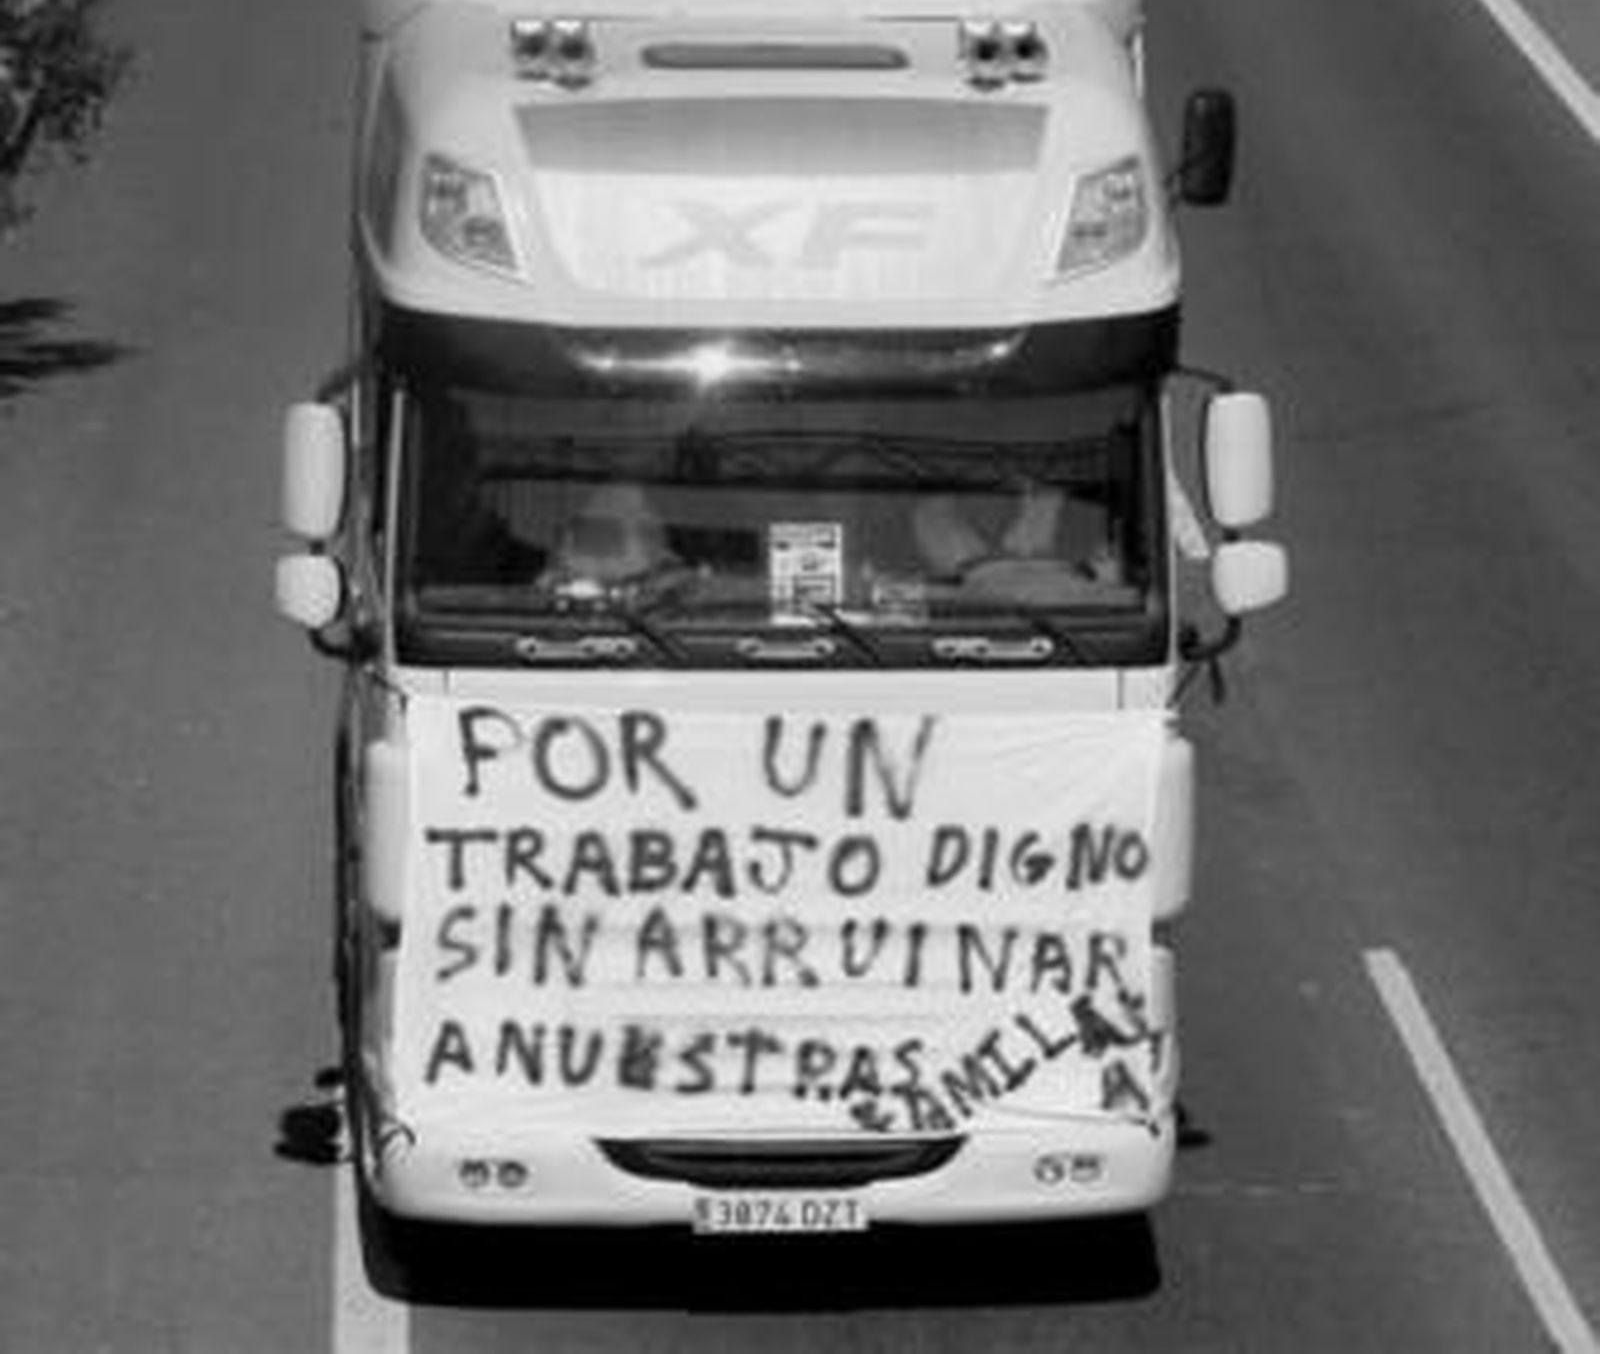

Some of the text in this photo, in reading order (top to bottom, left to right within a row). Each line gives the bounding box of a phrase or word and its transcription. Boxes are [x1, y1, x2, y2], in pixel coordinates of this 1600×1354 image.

[638, 200, 938, 270] XF
[458, 707, 936, 820] POR UN
[424, 822, 1151, 898] TRABAJO DIGNO
[436, 904, 1132, 1004] SIN ARRUINAR
